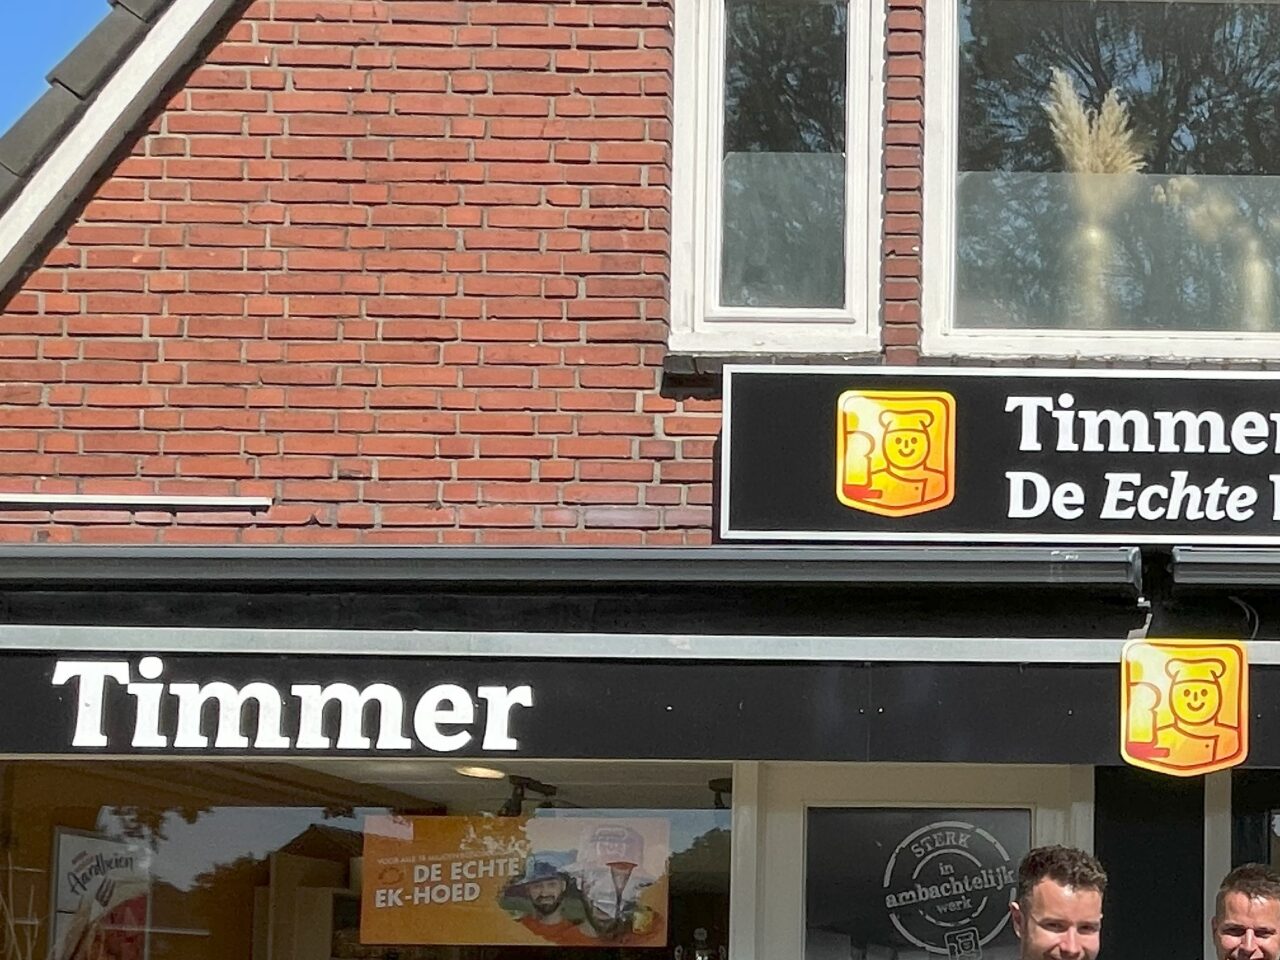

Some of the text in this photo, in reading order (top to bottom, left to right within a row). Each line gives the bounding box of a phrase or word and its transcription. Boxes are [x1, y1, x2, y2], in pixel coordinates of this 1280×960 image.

[1006, 471, 1084, 519] De
[1099, 470, 1257, 521] Echte
[52, 656, 533, 752] Timmer
[911, 831, 972, 858] STERK
[68, 852, 134, 895] Aardbeien
[414, 857, 520, 883] DE ECHTE
[938, 863, 955, 876] in
[375, 882, 481, 908] EK-HOED
[885, 866, 1016, 908] ambachtelijk
[935, 896, 973, 914] werk
